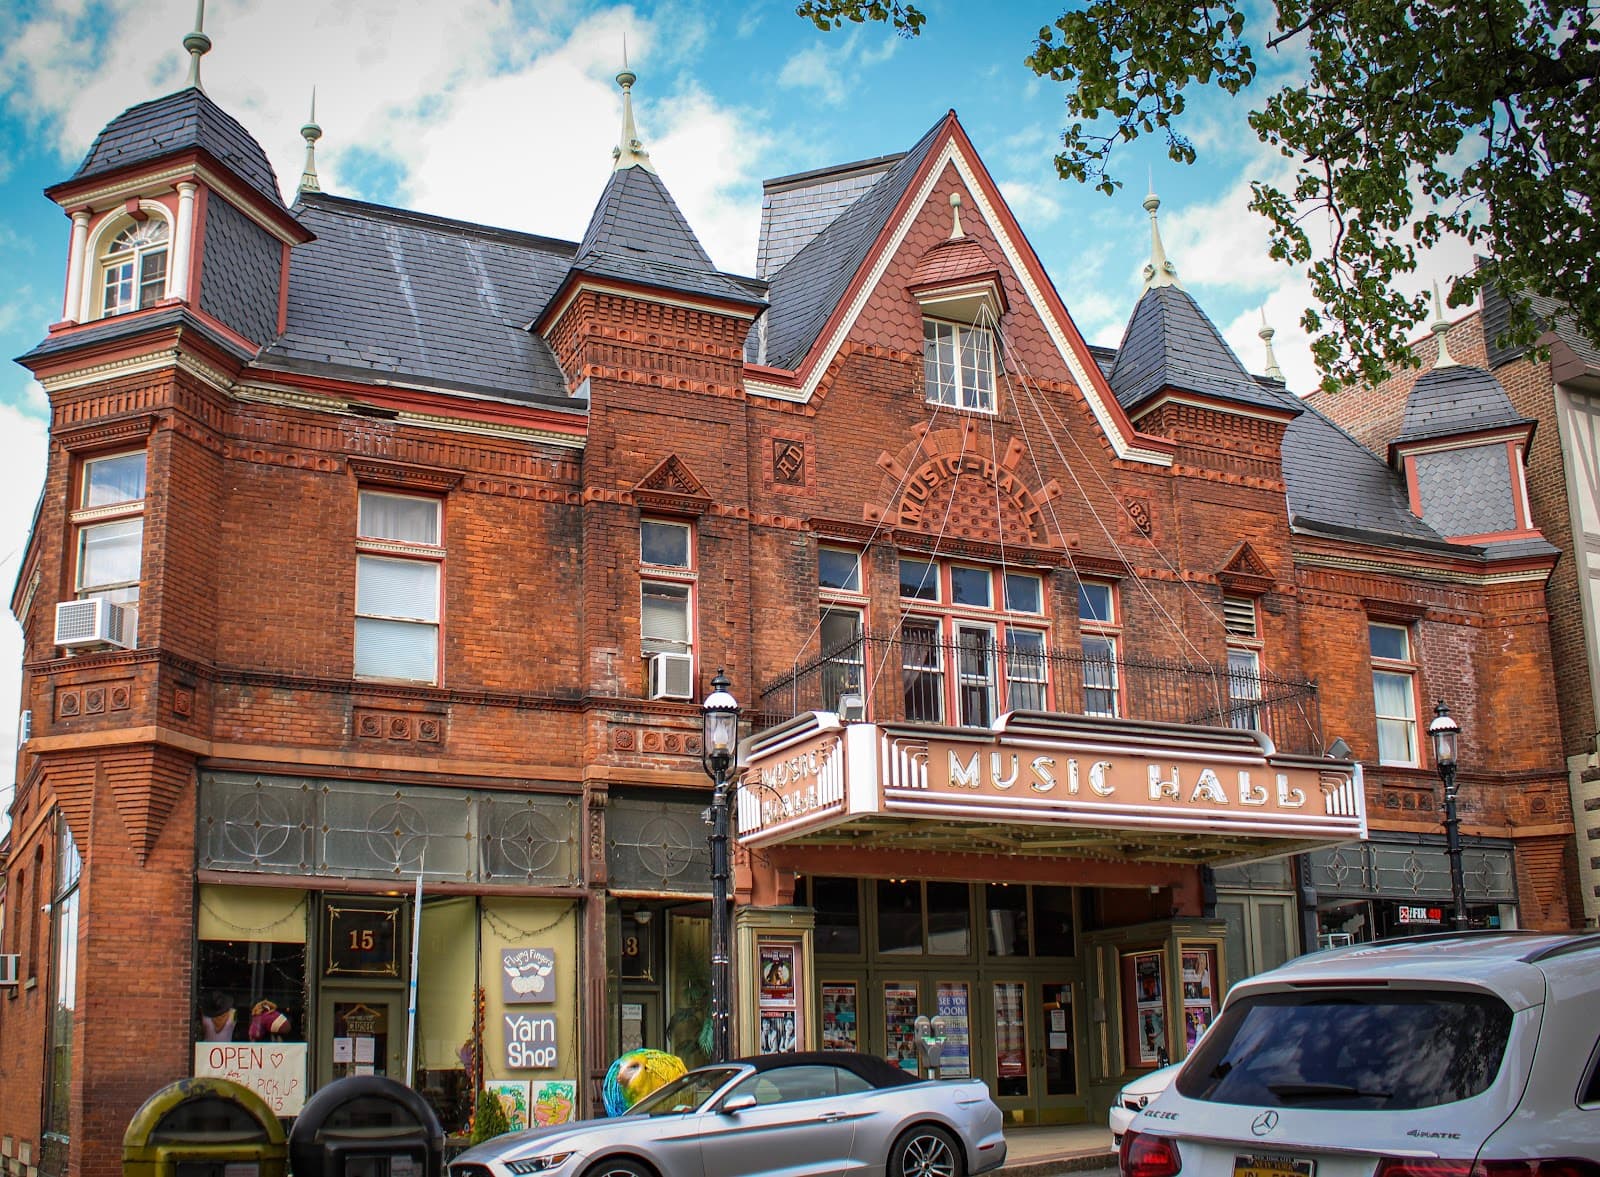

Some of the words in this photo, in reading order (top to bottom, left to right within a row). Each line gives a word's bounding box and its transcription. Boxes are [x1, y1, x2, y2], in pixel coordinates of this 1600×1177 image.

[1128, 500, 1150, 532] 1885
[762, 749, 821, 788] MUSIC
[948, 750, 1115, 797] MUSIC
[1146, 764, 1306, 809] HALL
[349, 930, 374, 950] 15
[503, 949, 529, 966] Flying
[939, 997, 951, 1006] SEE
[952, 997, 966, 1006] YOU
[939, 1006, 966, 1016] SOON!
[505, 1015, 555, 1041] Yarn
[209, 1047, 263, 1069] OPEN
[508, 1042, 556, 1068] Shop
[257, 1078, 279, 1096] PICK
[283, 1079, 298, 1097] UP
